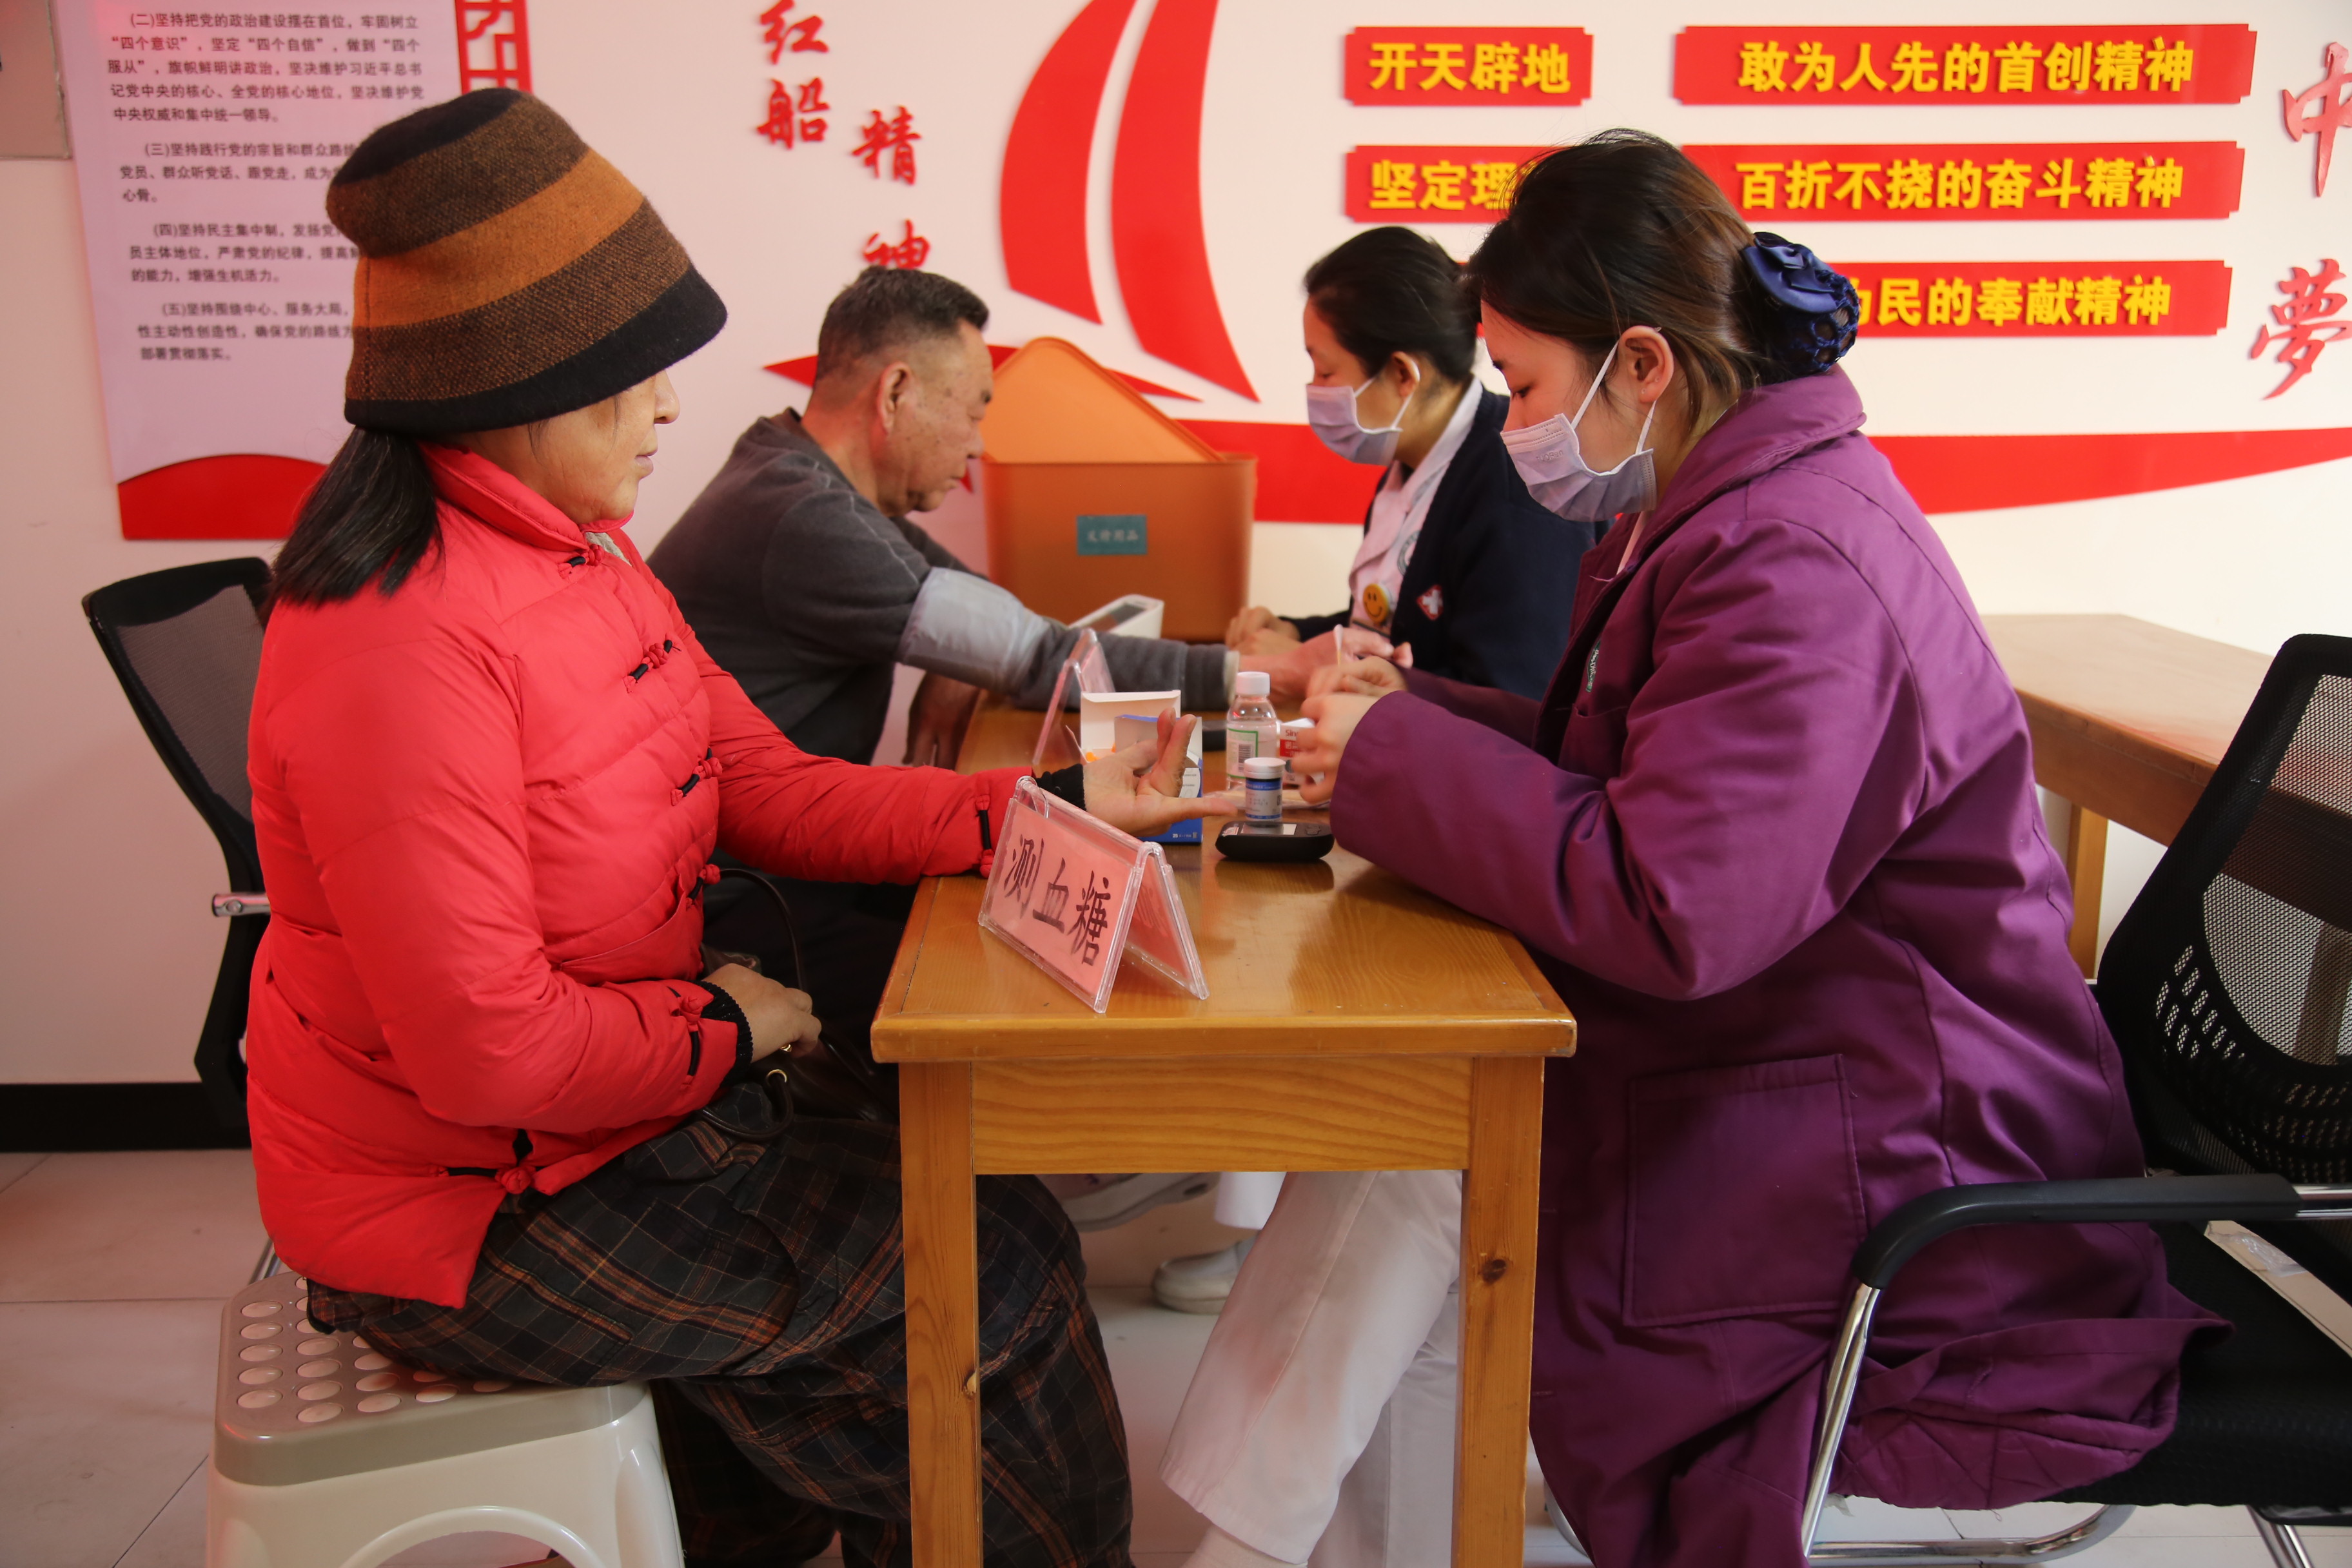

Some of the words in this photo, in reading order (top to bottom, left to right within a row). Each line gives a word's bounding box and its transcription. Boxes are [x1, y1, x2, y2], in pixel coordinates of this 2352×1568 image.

[756, 0, 830, 150] 红船
[1369, 41, 1571, 94] 开天辟地
[1738, 36, 2194, 93] 敢为人先的首创精神
[120, 165, 341, 180] 党员、群众听党话、跟党走，成为
[1369, 160, 1537, 210] 坚定理
[1736, 157, 2184, 210] 百折不挠的奋斗精神
[153, 223, 340, 237] (四)坚持民主集中制，发扬党
[1003, 833, 1112, 966] 测血糖
